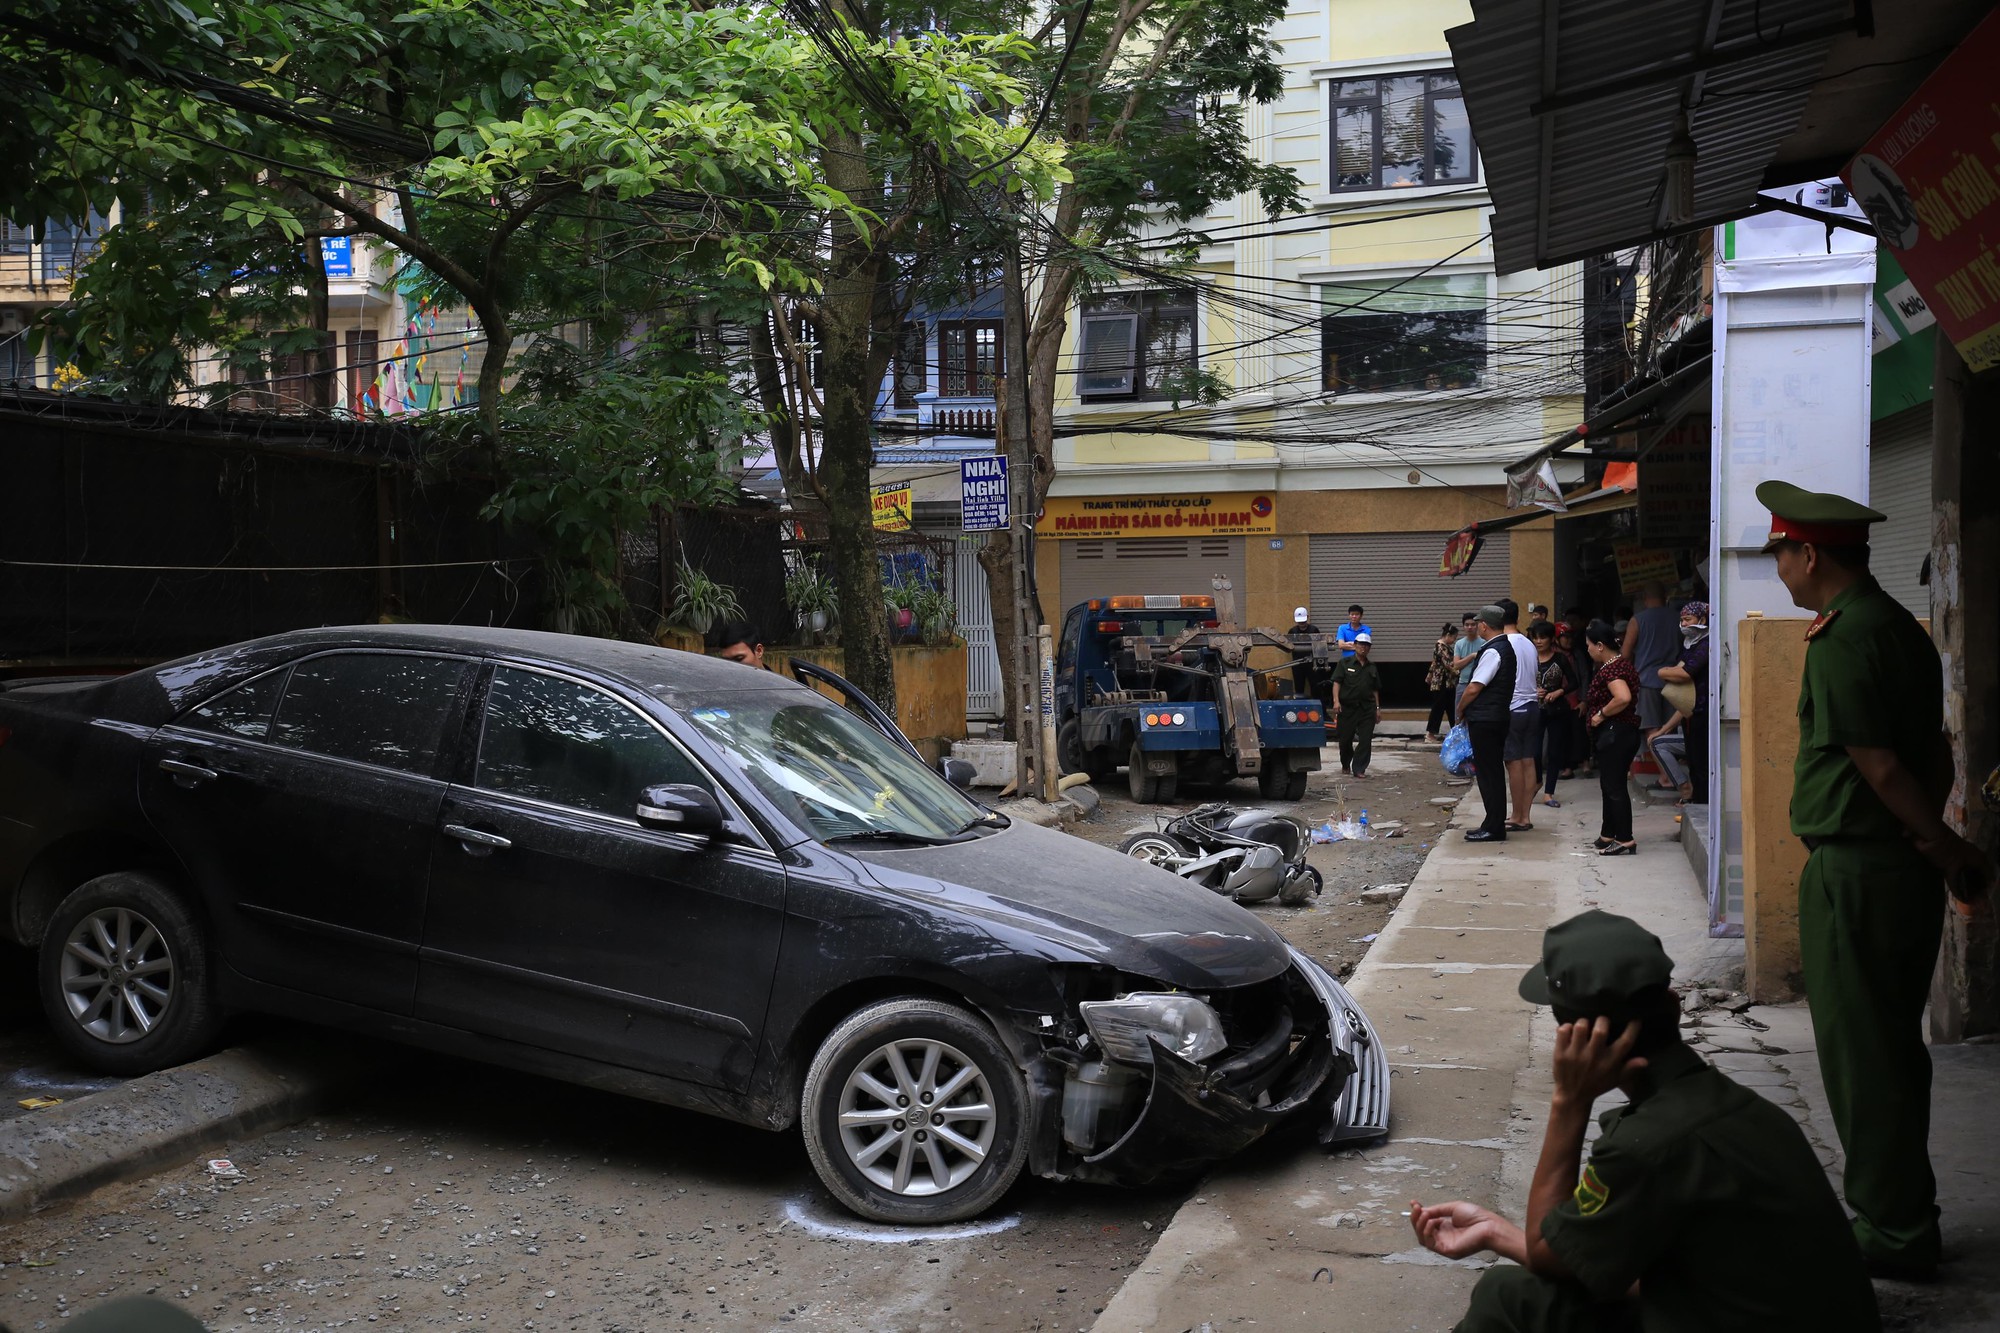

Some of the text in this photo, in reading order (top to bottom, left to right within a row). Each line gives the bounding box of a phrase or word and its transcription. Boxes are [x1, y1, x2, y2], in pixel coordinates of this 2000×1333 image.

[1911, 176, 1961, 241] SỬA
[1935, 267, 1986, 321] THAY
[965, 457, 1002, 477] NHÀ
[963, 473, 1006, 497] NGHỈ
[884, 494, 898, 511] DỊCH
[900, 491, 908, 508] VỤ
[1083, 496, 1212, 510] TRANG TRÍ NỘI THẤT CAO CẤP
[1055, 513, 1098, 530] MÀNH
[1100, 512, 1129, 529] RÈM
[1132, 511, 1162, 529] SÀN
[1218, 512, 1251, 526] NAM
[1271, 541, 1281, 549] 68
